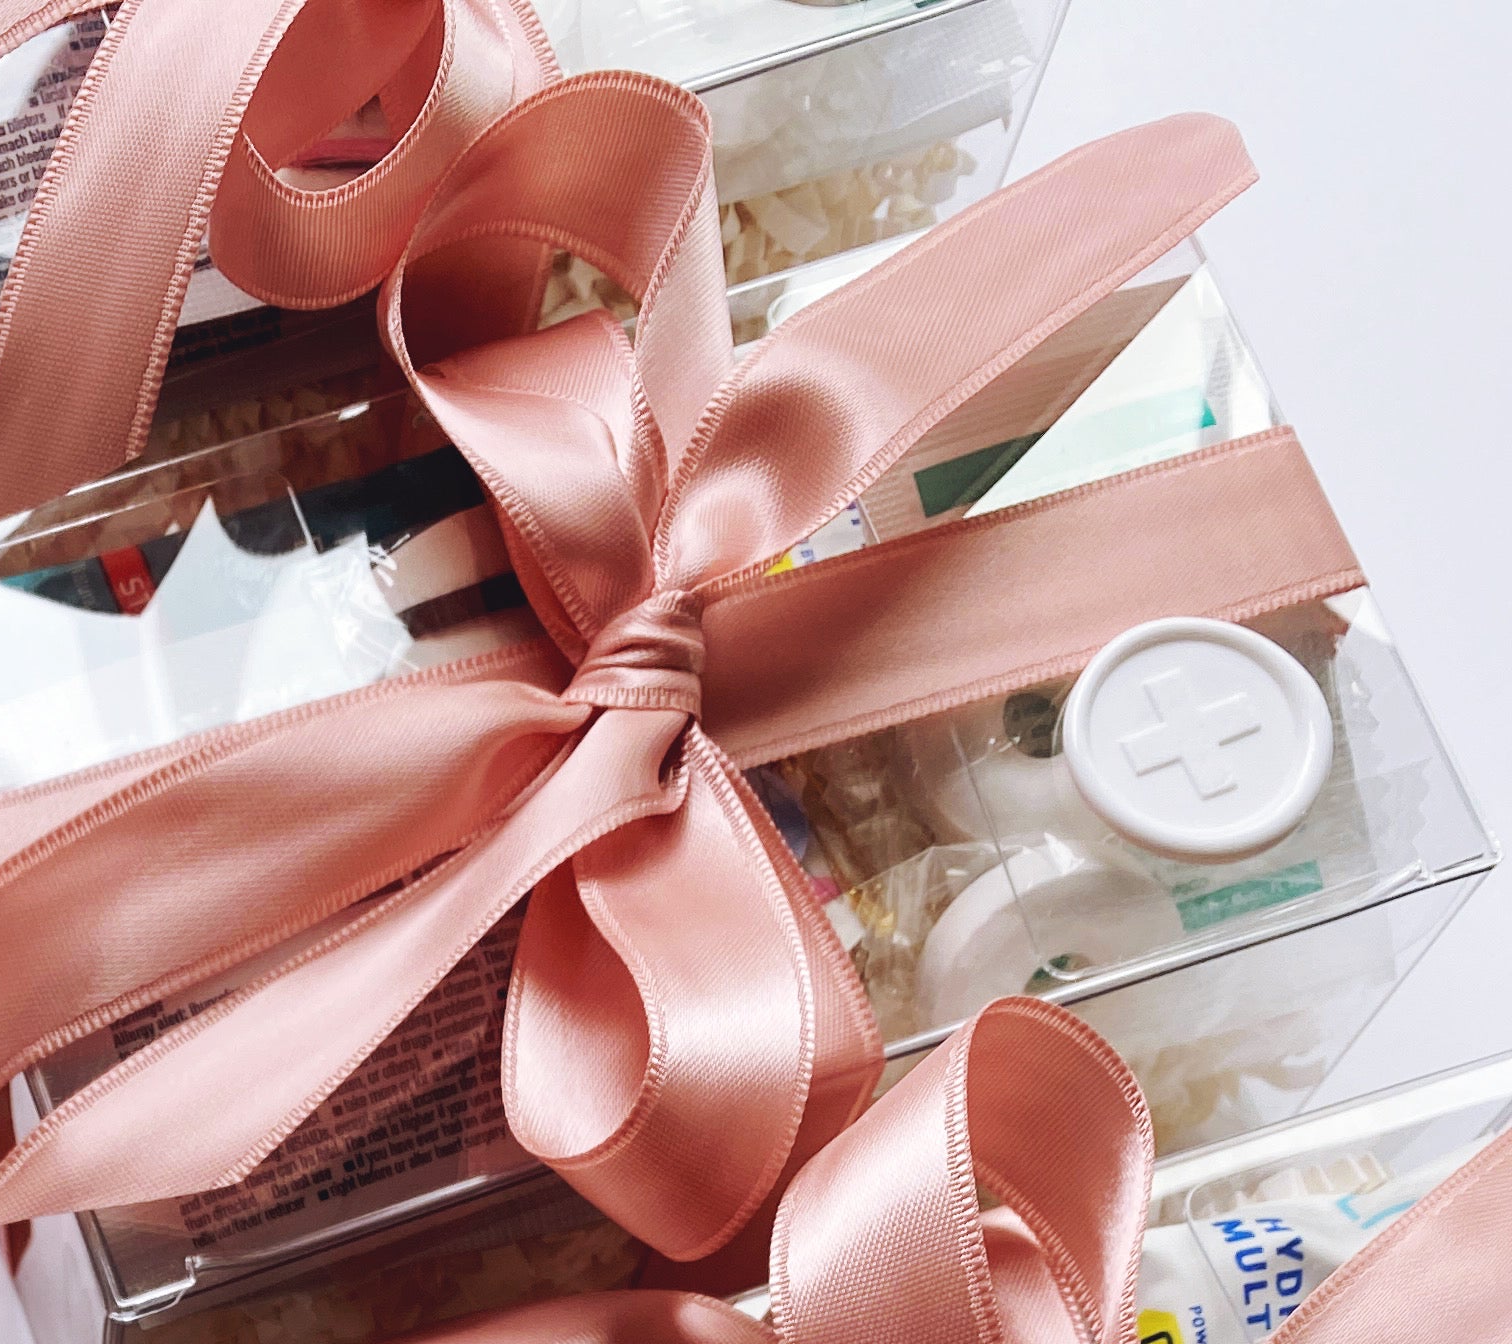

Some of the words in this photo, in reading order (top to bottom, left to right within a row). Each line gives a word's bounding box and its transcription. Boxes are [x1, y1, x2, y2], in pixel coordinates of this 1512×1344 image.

[6, 111, 46, 135] blisters
[19, 170, 29, 182] or
[113, 1020, 157, 1050] Allergy
[1212, 1219, 1271, 1331] MULT
